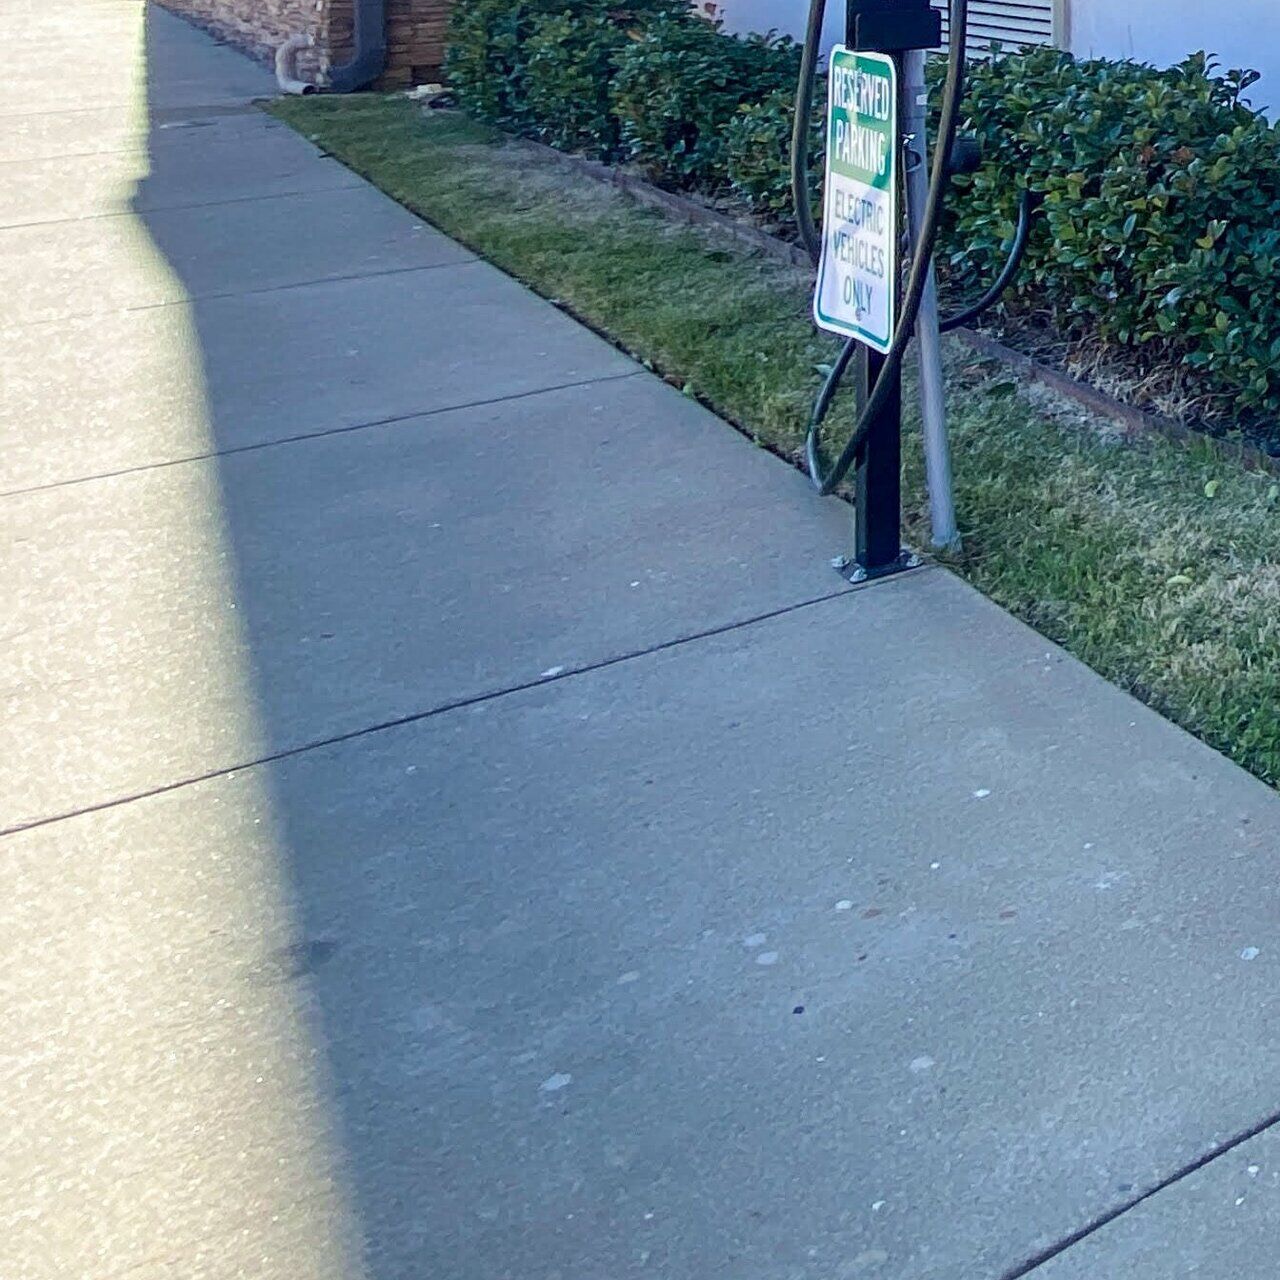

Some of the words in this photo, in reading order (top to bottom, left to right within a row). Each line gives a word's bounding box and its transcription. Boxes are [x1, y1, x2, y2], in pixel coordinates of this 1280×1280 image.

[834, 65, 889, 121] RESERVED
[835, 118, 886, 176] PARKING
[835, 189, 884, 236] ELECTRIC
[833, 230, 885, 280] VEHICLES
[843, 275, 873, 315] ONLY
